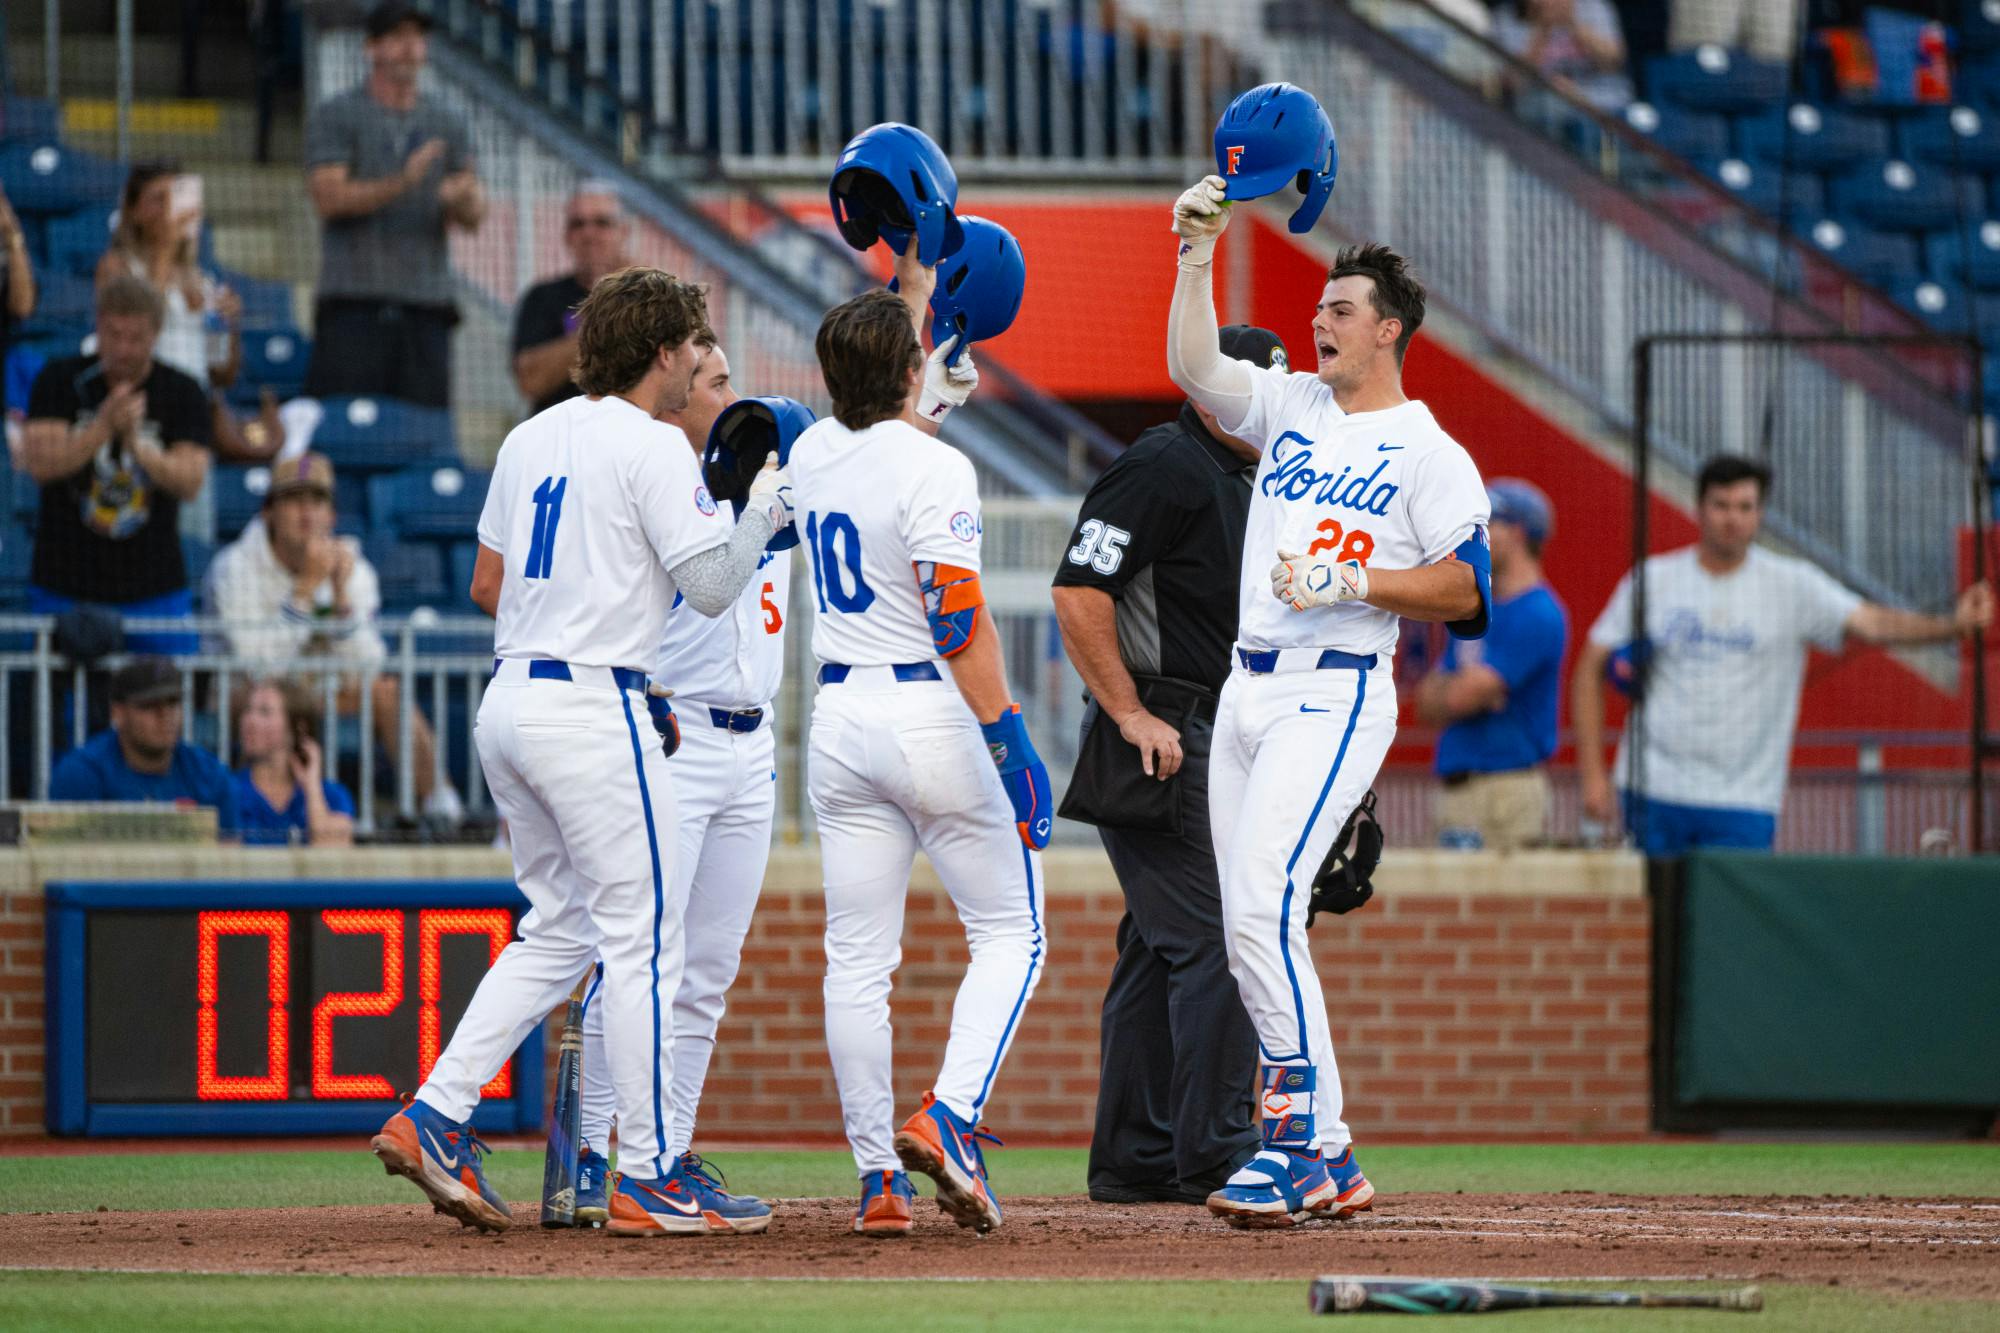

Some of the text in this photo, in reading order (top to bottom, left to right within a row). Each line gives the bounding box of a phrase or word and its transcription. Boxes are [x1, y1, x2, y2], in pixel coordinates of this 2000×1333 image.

[1226, 146, 1245, 175] F
[928, 402, 947, 417] F
[1261, 430, 1399, 517] Florida
[524, 476, 567, 579] 11
[1068, 518, 1131, 576] 35
[1308, 518, 1375, 568] 28
[805, 511, 875, 614] 10
[760, 582, 783, 635] 5
